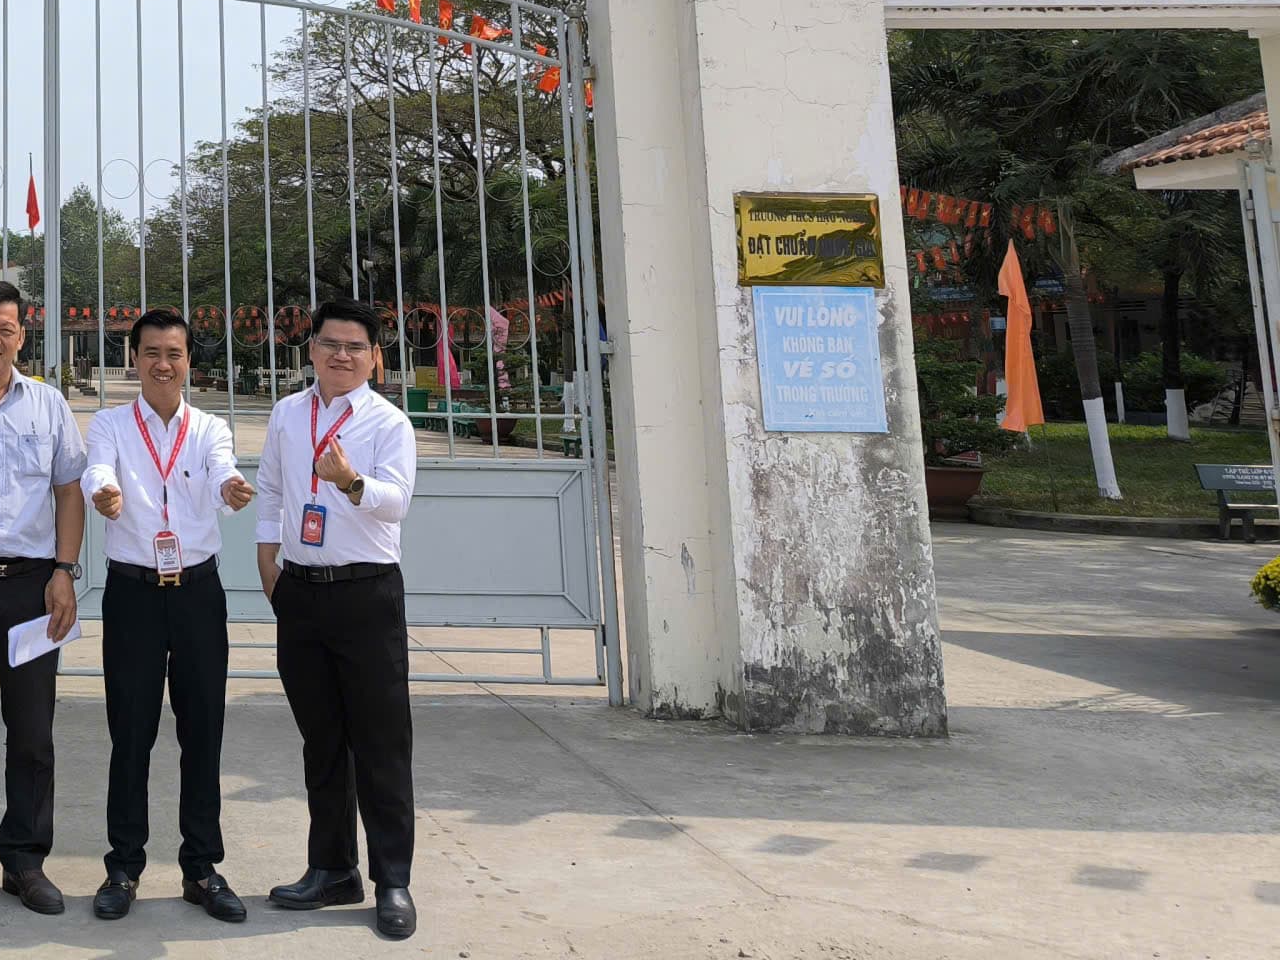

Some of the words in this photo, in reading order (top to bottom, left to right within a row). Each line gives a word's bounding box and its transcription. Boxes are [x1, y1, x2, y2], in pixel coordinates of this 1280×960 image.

[748, 234, 771, 259] ĐẠT
[775, 229, 817, 256] CHUẨN
[775, 305, 803, 327] VUI
